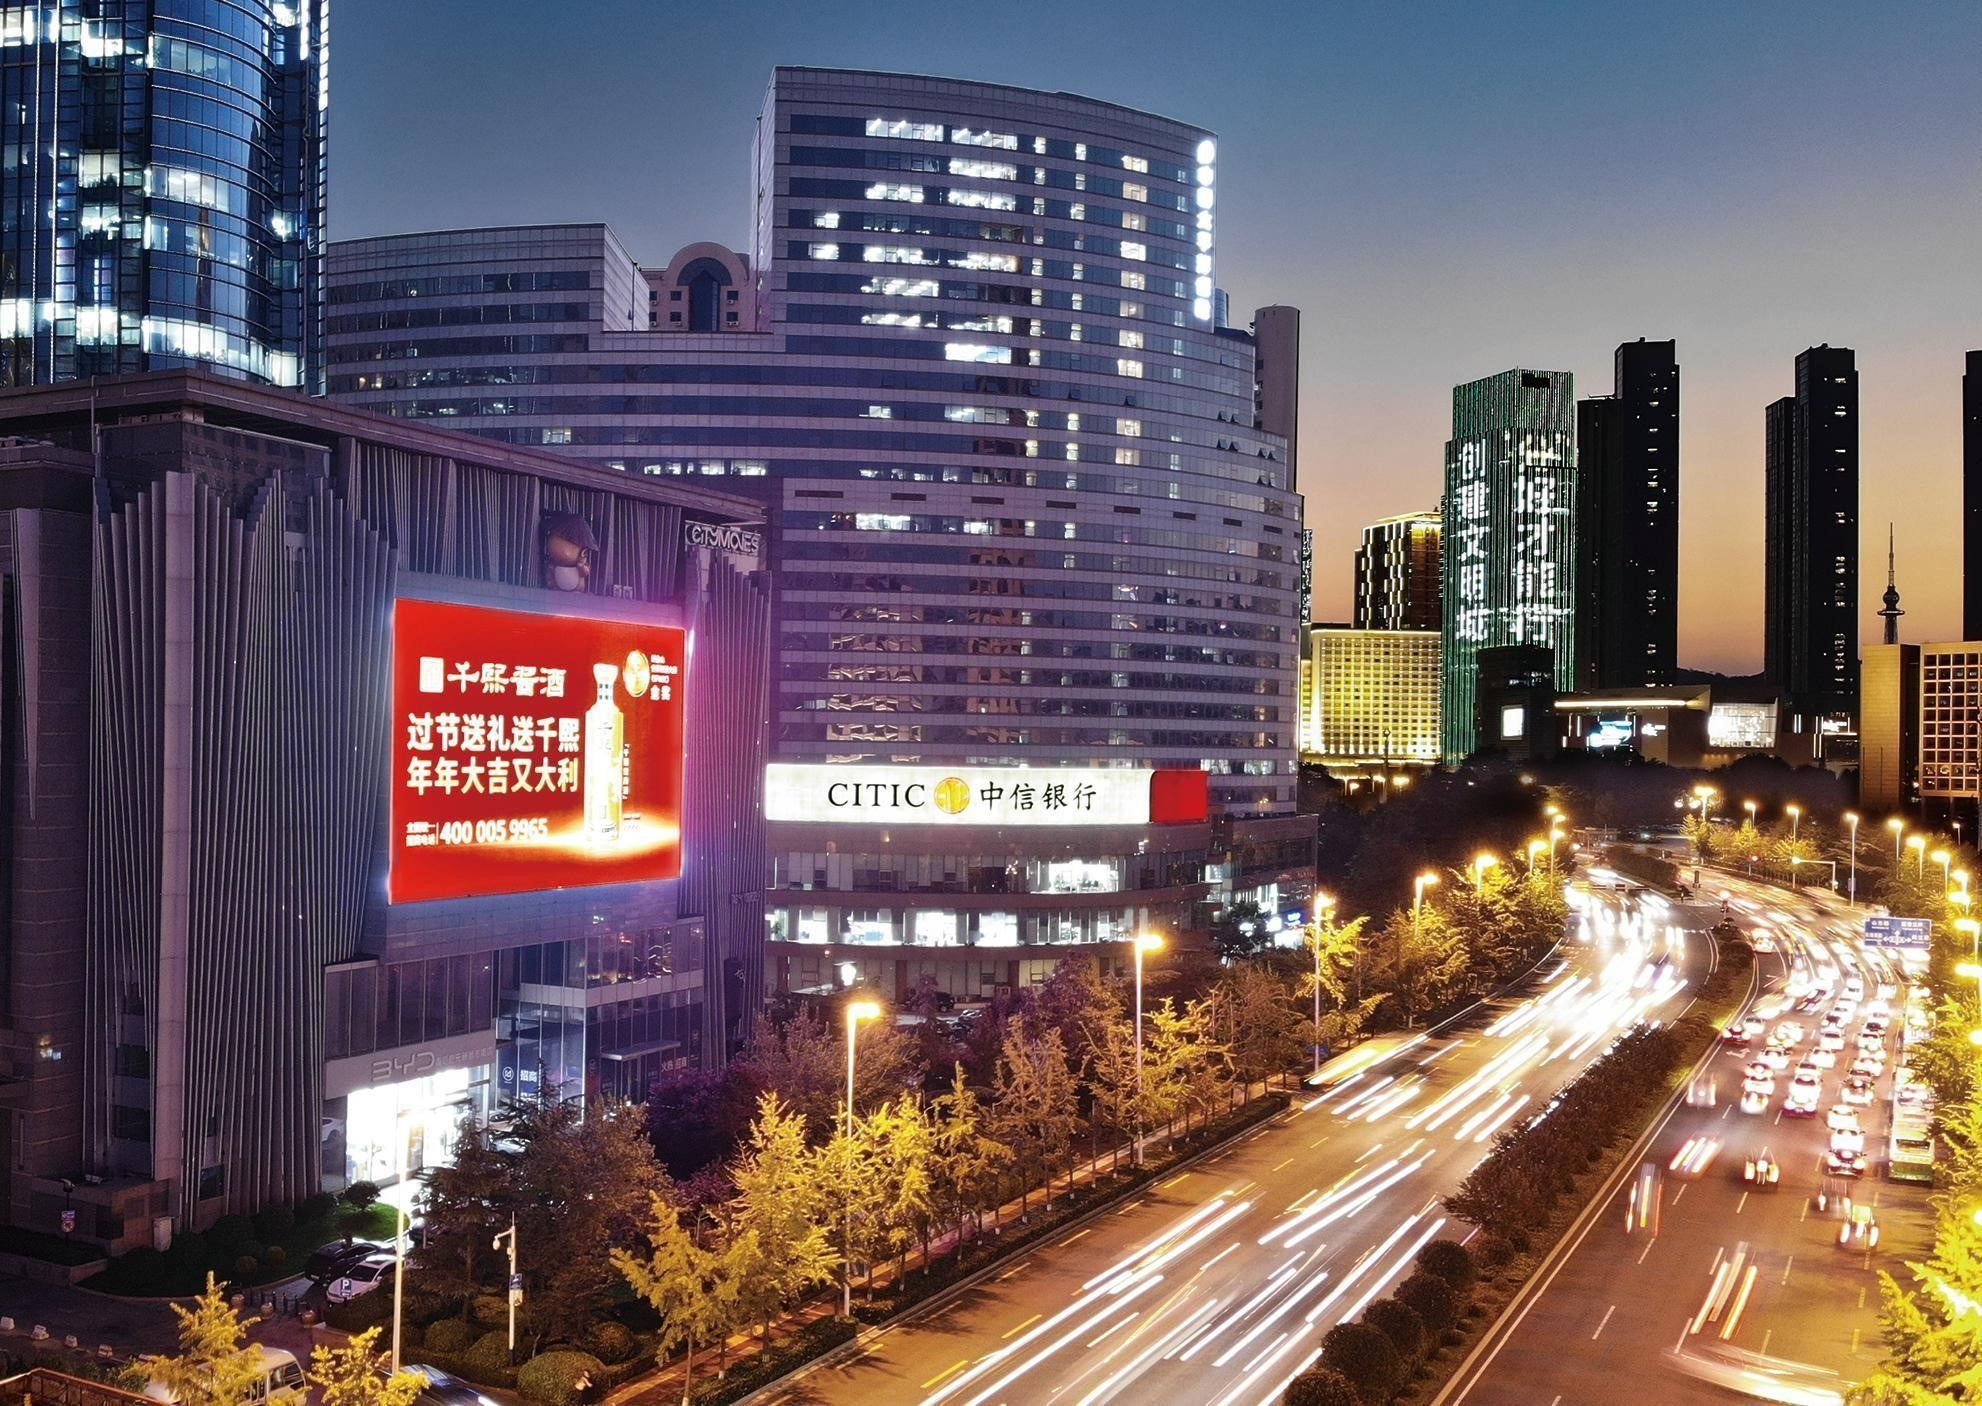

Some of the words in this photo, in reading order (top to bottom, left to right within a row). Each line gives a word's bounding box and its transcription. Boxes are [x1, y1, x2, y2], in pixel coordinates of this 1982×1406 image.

[407, 712, 580, 752] 过节送礼送千熙
[406, 756, 579, 795] 年年大吉又大利
[827, 782, 926, 807] CITIC
[979, 781, 1097, 811] 中信银行
[440, 820, 473, 844] 400
[475, 819, 507, 843] 005
[508, 817, 549, 841] 9965
[372, 1051, 435, 1081] BYD
